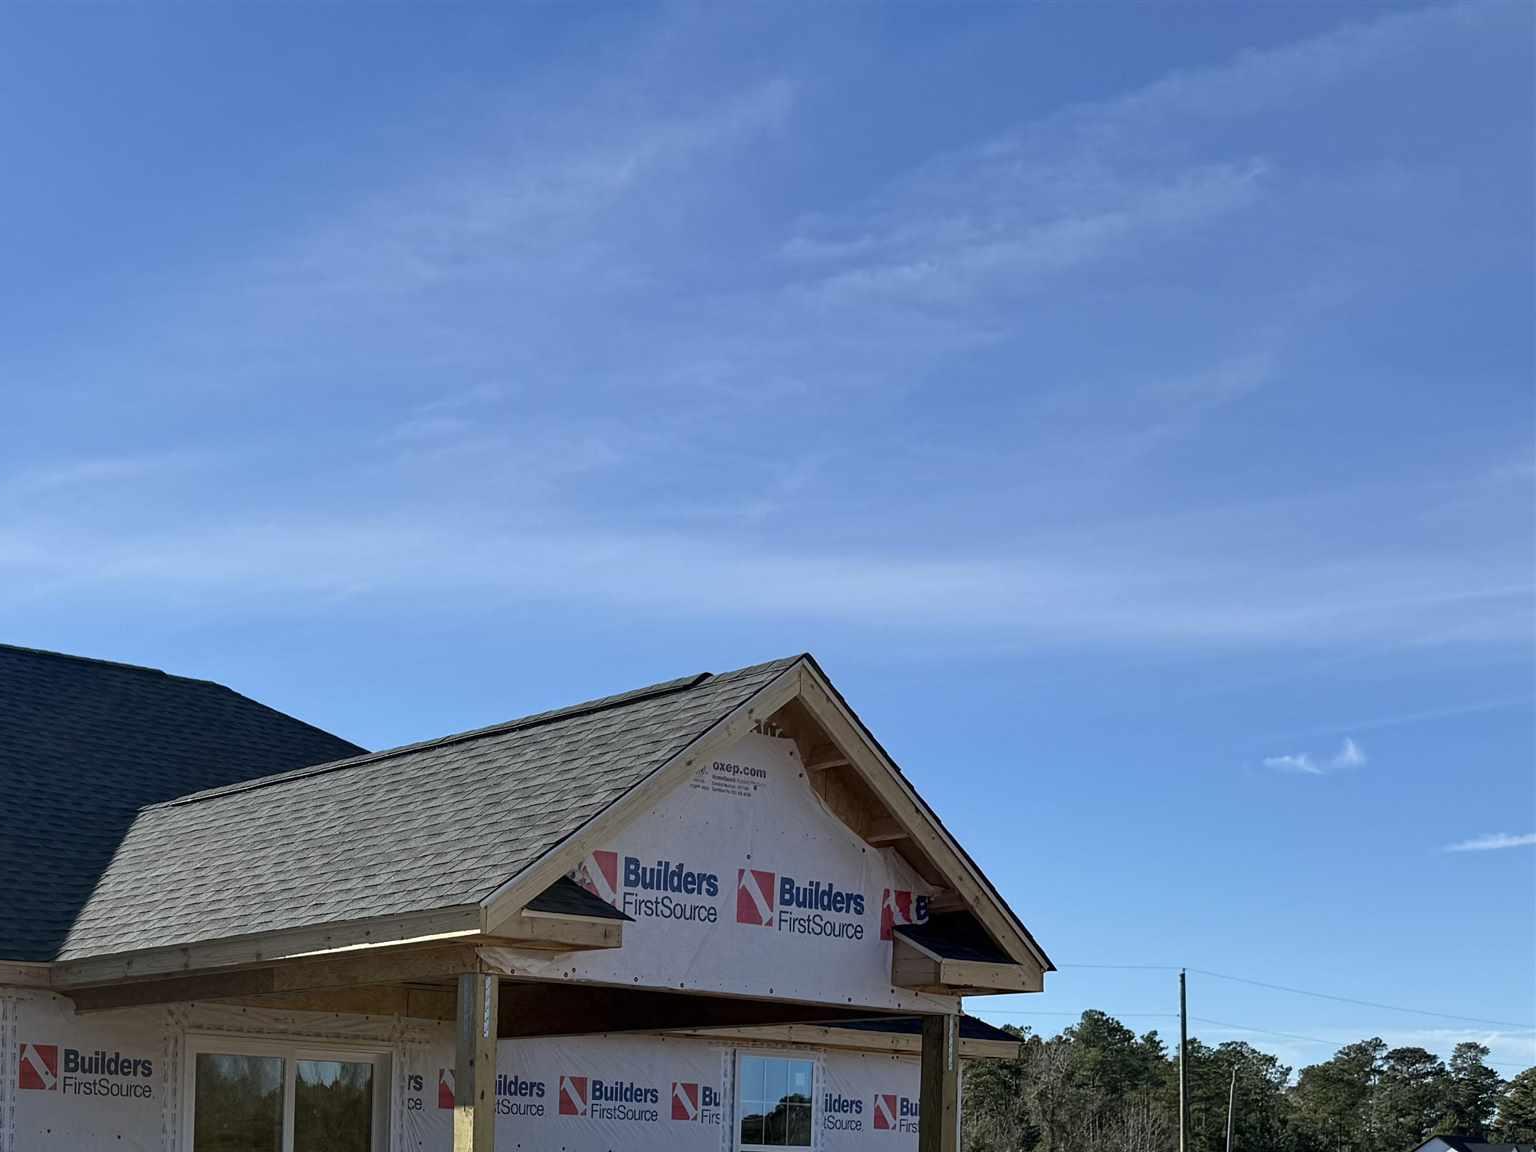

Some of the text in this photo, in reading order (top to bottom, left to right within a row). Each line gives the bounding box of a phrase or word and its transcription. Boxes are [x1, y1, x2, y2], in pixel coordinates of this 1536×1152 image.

[712, 761, 767, 778] oxep.com
[624, 856, 718, 897] Builders
[623, 894, 718, 923] FirstSource
[779, 877, 864, 915] Builders
[778, 913, 864, 940] FirstSource
[64, 1048, 153, 1078] Builders
[591, 1080, 658, 1104] Builders
[591, 1103, 658, 1123] FirstSource
